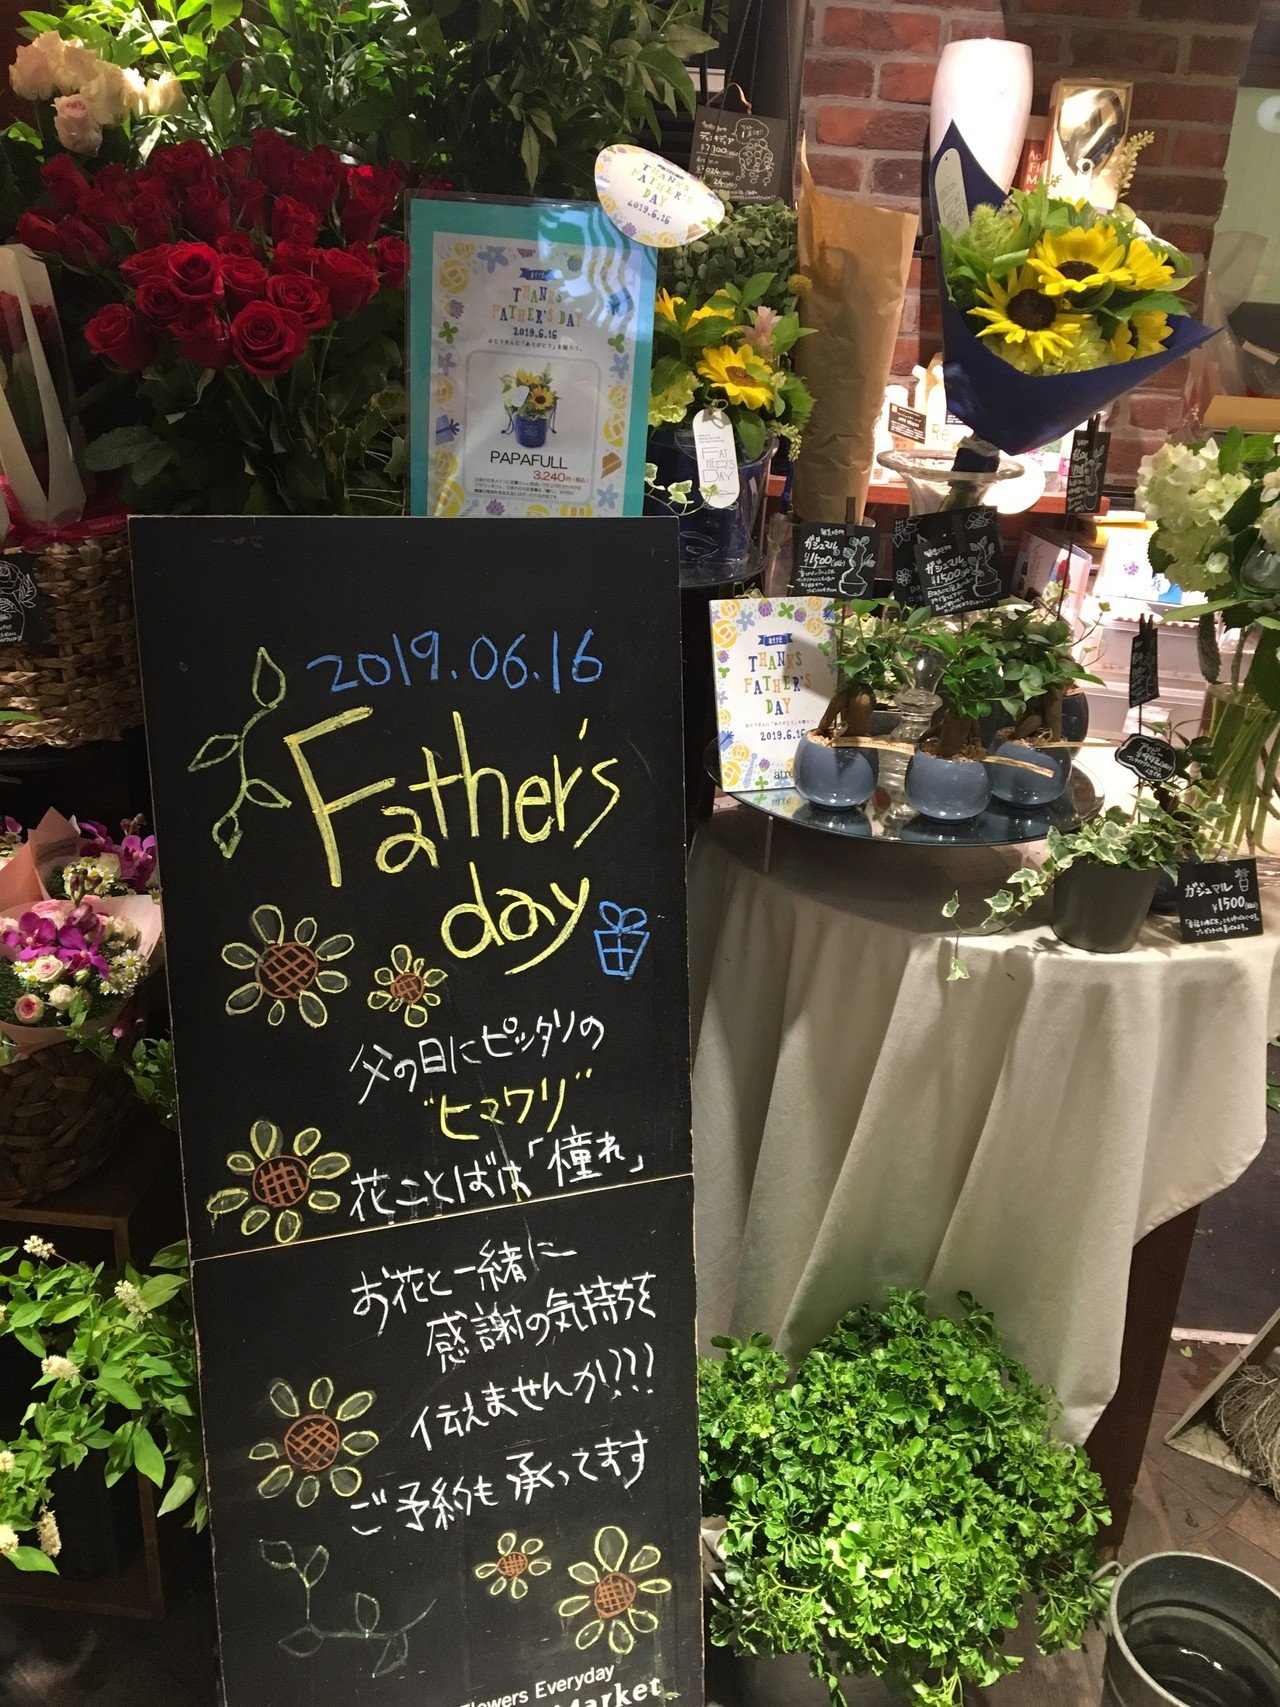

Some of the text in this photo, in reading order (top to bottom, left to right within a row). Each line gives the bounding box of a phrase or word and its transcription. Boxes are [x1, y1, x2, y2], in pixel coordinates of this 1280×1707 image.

[642, 188, 668, 208] DAY
[627, 199, 672, 225] 2019.6.16
[513, 284, 562, 304] THANKS
[491, 303, 583, 327] FATHER'S DAY
[513, 326, 558, 340] 2019.6.16
[490, 450, 568, 470] PAPAFULL
[703, 469, 735, 482] DAY
[306, 628, 603, 694] 2019.06.16
[748, 651, 802, 672] THANKS
[744, 672, 812, 695] FATHER'S
[765, 697, 791, 715] DAY
[282, 706, 621, 888] Father's
[1184, 882, 1234, 898] ガジュマル
[440, 861, 590, 976] day
[348, 1008, 606, 1105] 父の日にピッタリの
[351, 1239, 578, 1337] お花と一緒に
[426, 1271, 657, 1374] 感謝の気持ちを
[460, 1664, 615, 1707] wers Everyday
